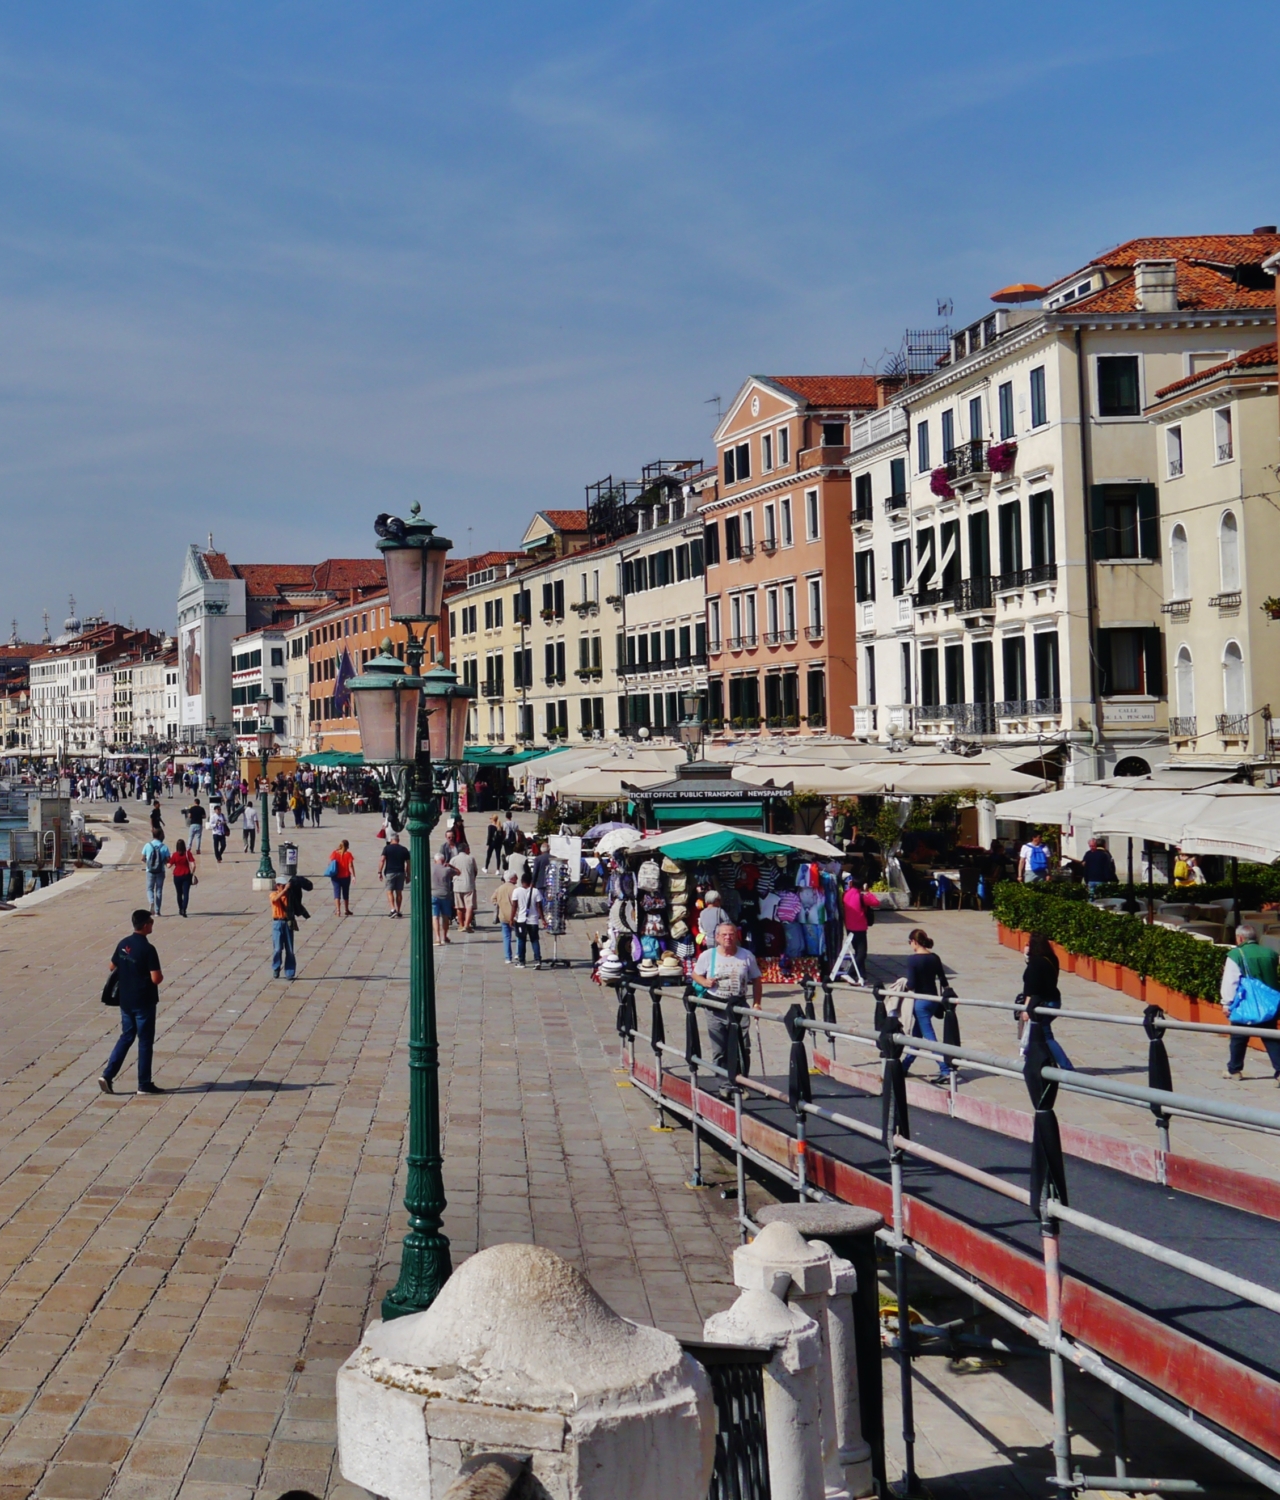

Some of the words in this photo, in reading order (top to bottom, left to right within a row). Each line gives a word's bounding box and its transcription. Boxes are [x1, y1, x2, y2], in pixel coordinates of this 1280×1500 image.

[630, 791, 652, 799] TICKET
[653, 791, 677, 799] OFFICE
[704, 790, 744, 798] TRANSPORT
[747, 789, 793, 797] NEWSPAPERS
